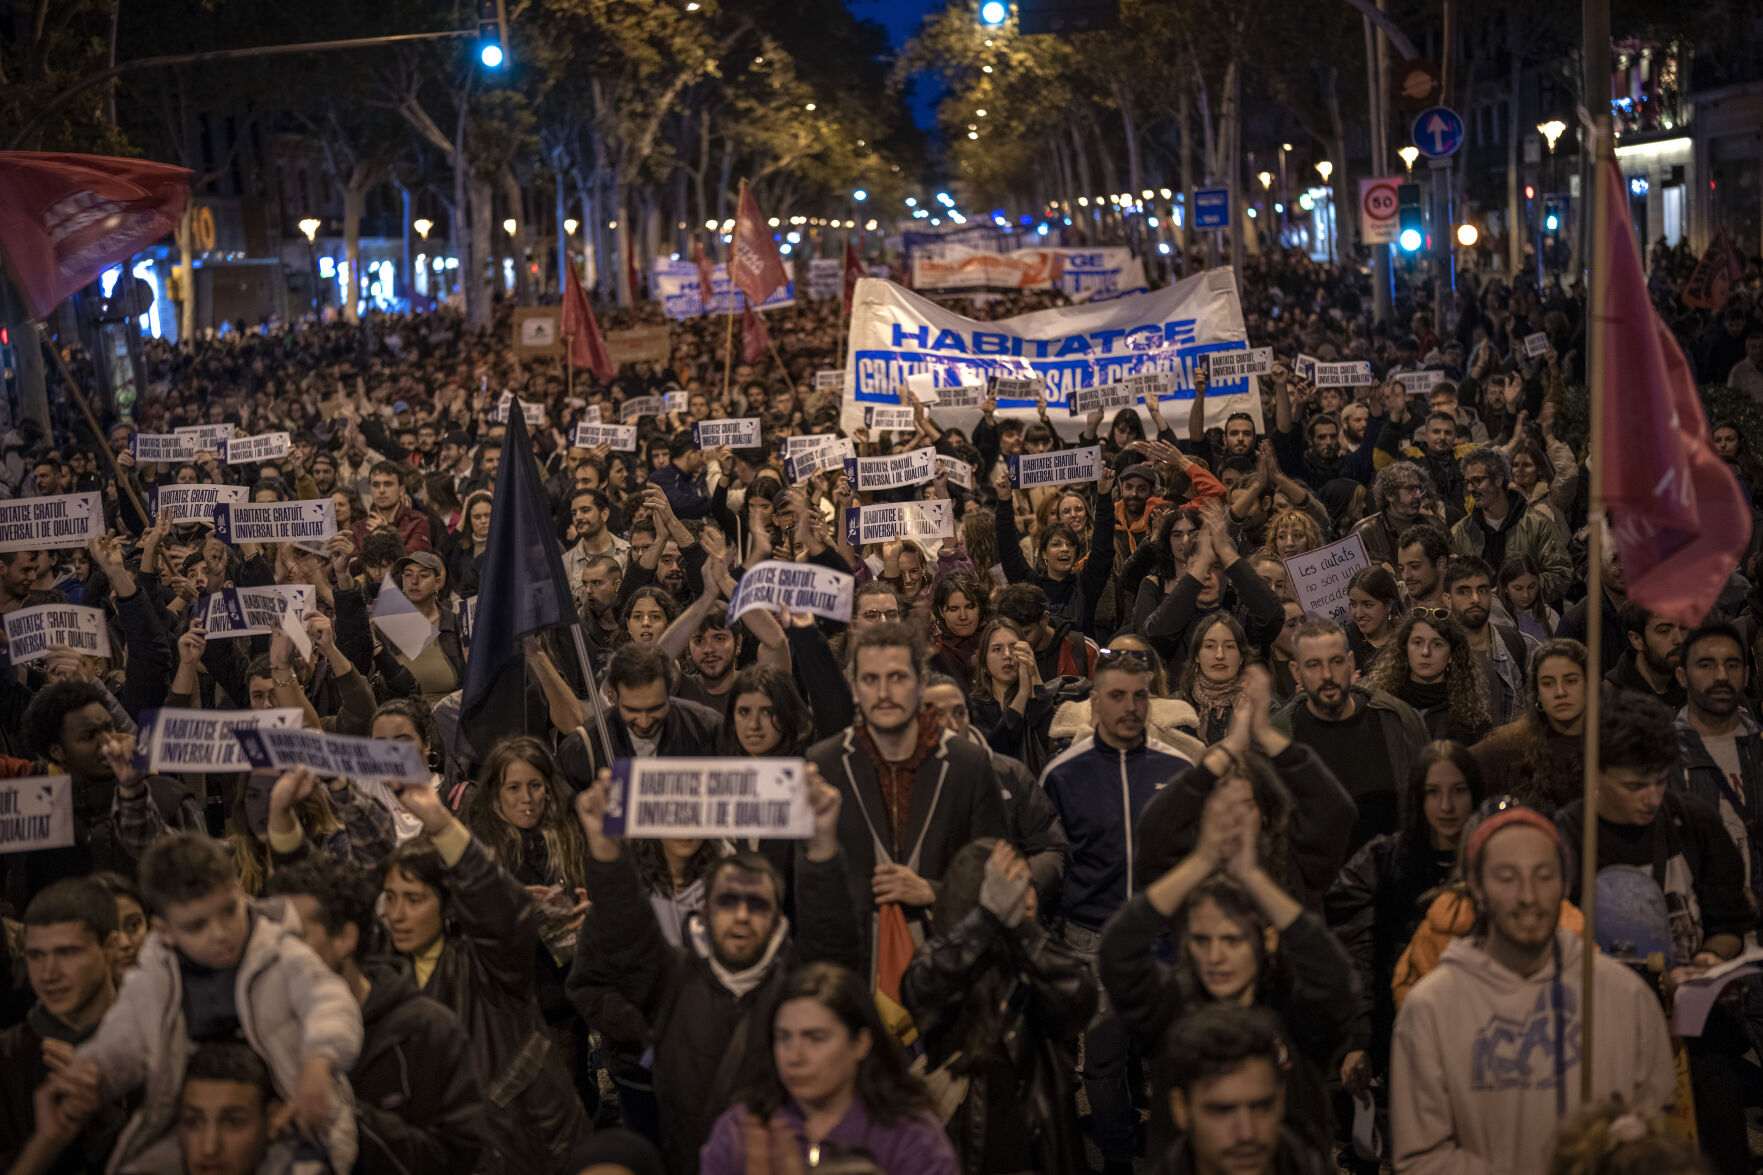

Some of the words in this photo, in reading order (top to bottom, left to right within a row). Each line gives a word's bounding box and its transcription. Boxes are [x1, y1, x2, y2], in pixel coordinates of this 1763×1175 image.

[892, 318, 1197, 358] HABITATGE
[860, 461, 889, 474] HABITATGE
[890, 455, 914, 471] GRATUÏT,
[1023, 456, 1053, 471] HABITATGE
[1054, 451, 1079, 468] GRATUÏT,
[861, 472, 891, 487] UNIVERSAL
[896, 472, 903, 484] DE
[904, 465, 929, 482] QUALITAT
[1023, 468, 1054, 484] UNIVERSAL
[1055, 469, 1058, 481] I
[1060, 467, 1066, 481] DE
[1068, 464, 1094, 480] QUALITAT
[160, 489, 191, 505] HABITATGE
[191, 487, 219, 503] GRATUÏT,
[34, 499, 69, 520] GRATUÏT,
[194, 503, 202, 517] DE
[234, 508, 272, 523] HABITATGE
[273, 504, 305, 521] GRATUÏT,
[36, 521, 39, 539] I
[41, 520, 51, 538] DE
[53, 517, 89, 537] QUALITAT
[235, 523, 275, 539] UNIVERSAL
[275, 524, 279, 538] I
[280, 522, 290, 537] DE
[291, 520, 324, 537] QUALITAT
[1299, 564, 1317, 577] Les
[1321, 547, 1355, 571] ciutats
[1306, 583, 1317, 593] no
